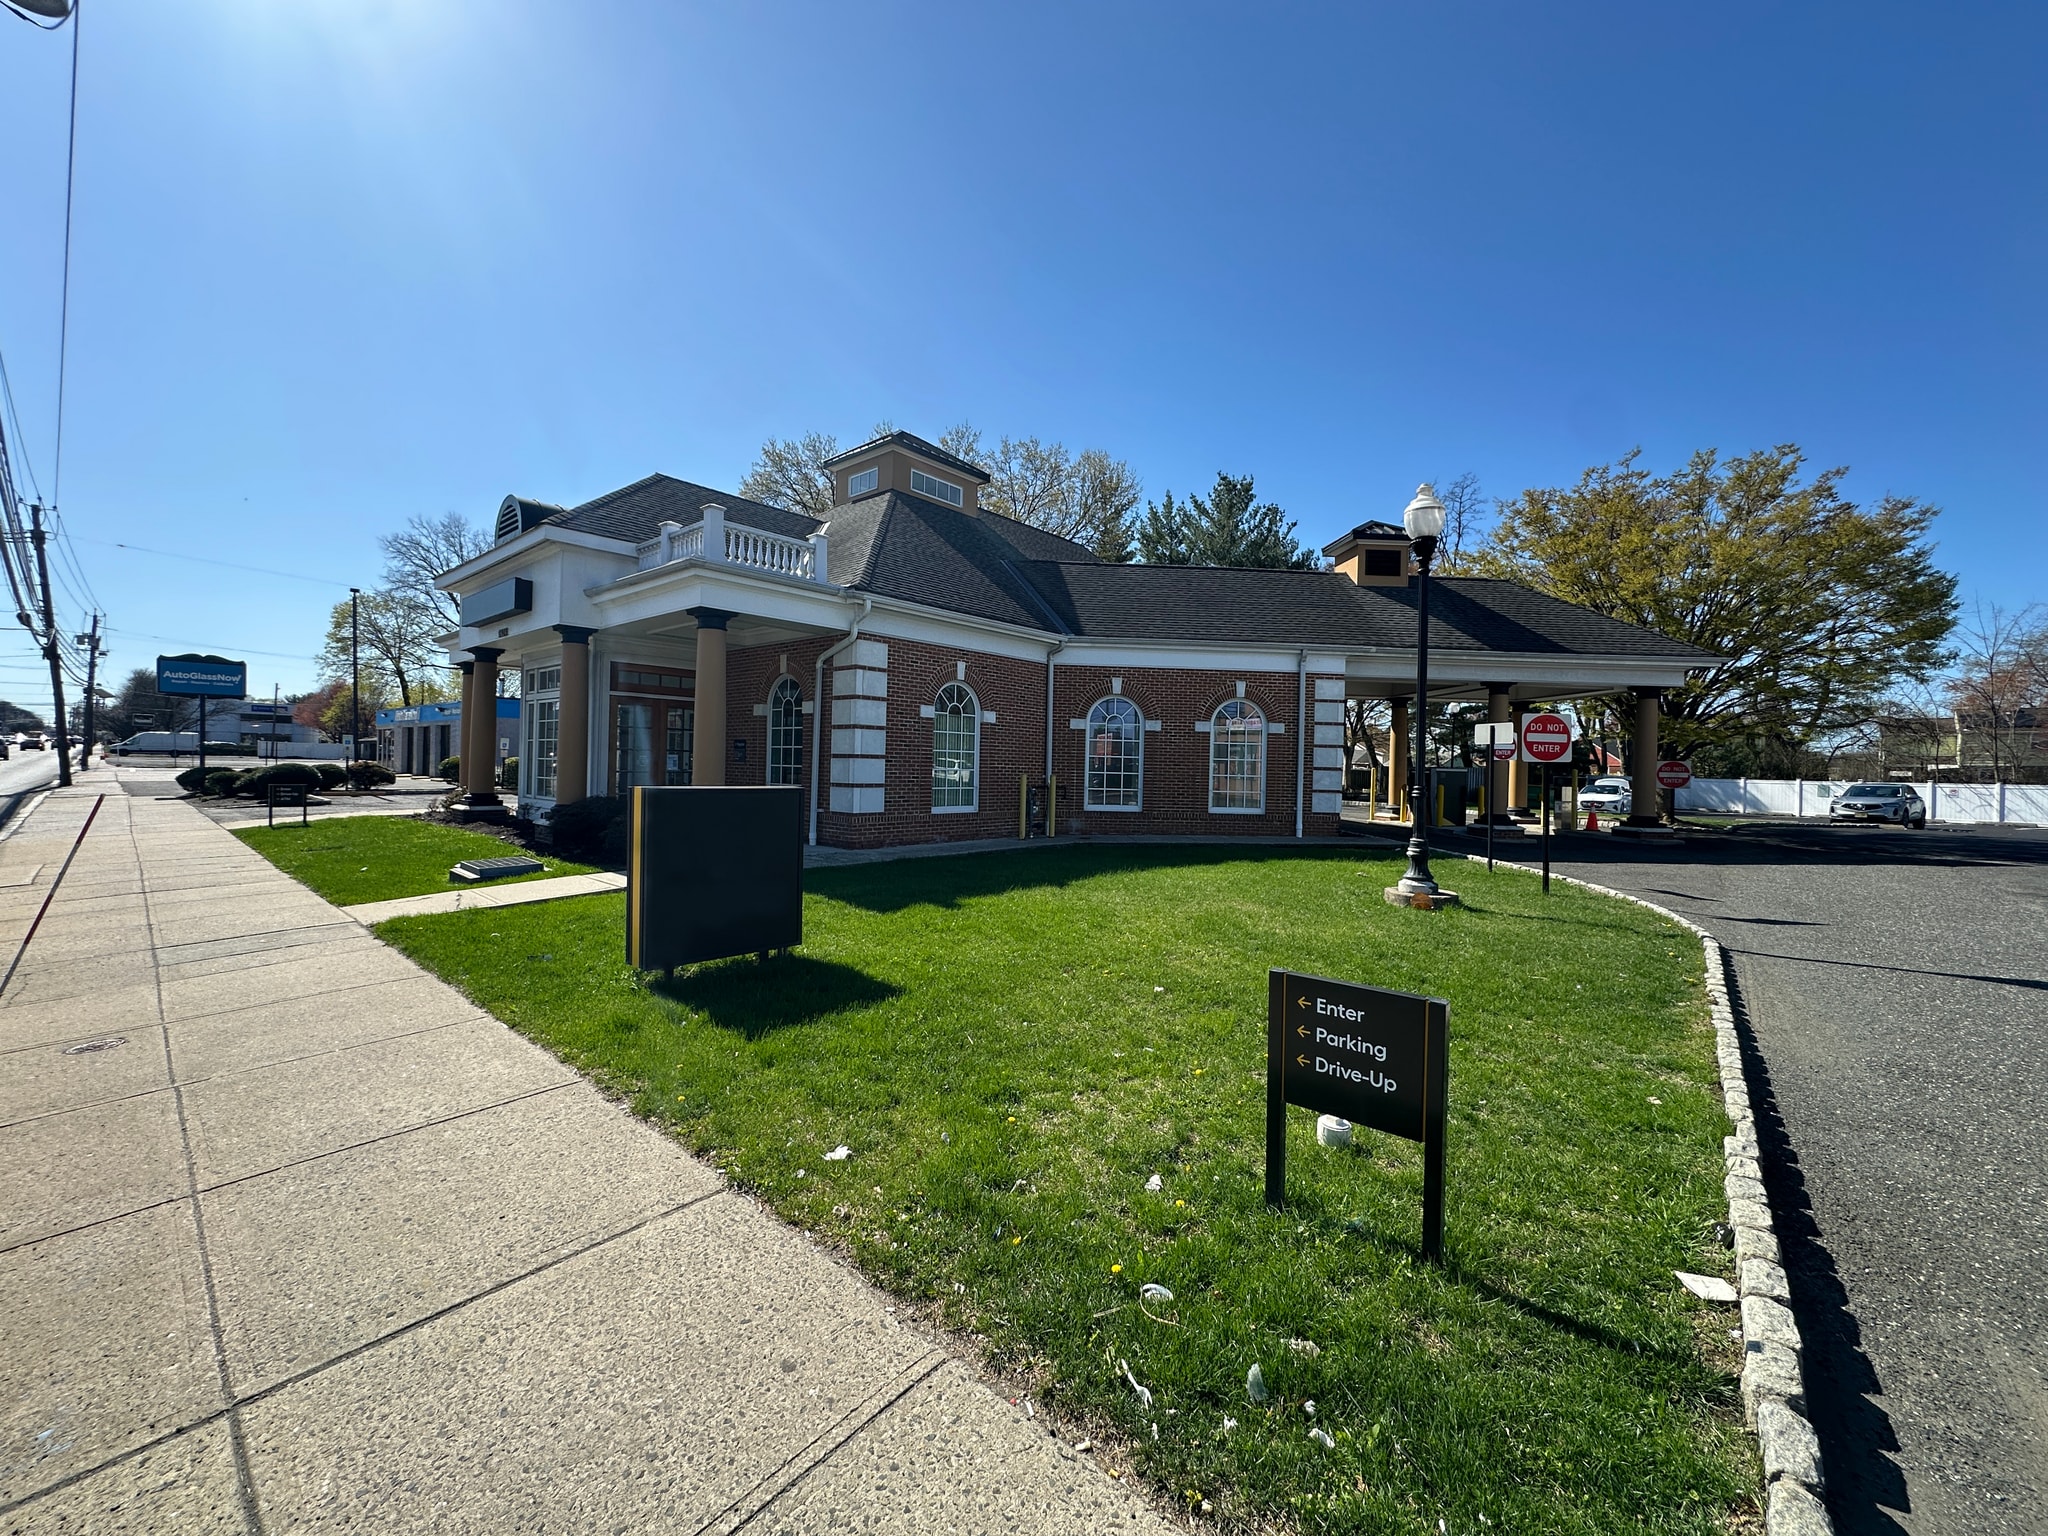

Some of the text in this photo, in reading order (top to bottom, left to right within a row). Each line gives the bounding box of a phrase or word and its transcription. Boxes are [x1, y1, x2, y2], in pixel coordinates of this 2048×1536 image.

[1530, 723, 1565, 732] DO NOT
[1533, 744, 1561, 753] ENTER
[1316, 997, 1365, 1022] Enter
[1315, 1027, 1387, 1062] Parking
[1315, 1056, 1398, 1093] Drive-Up
